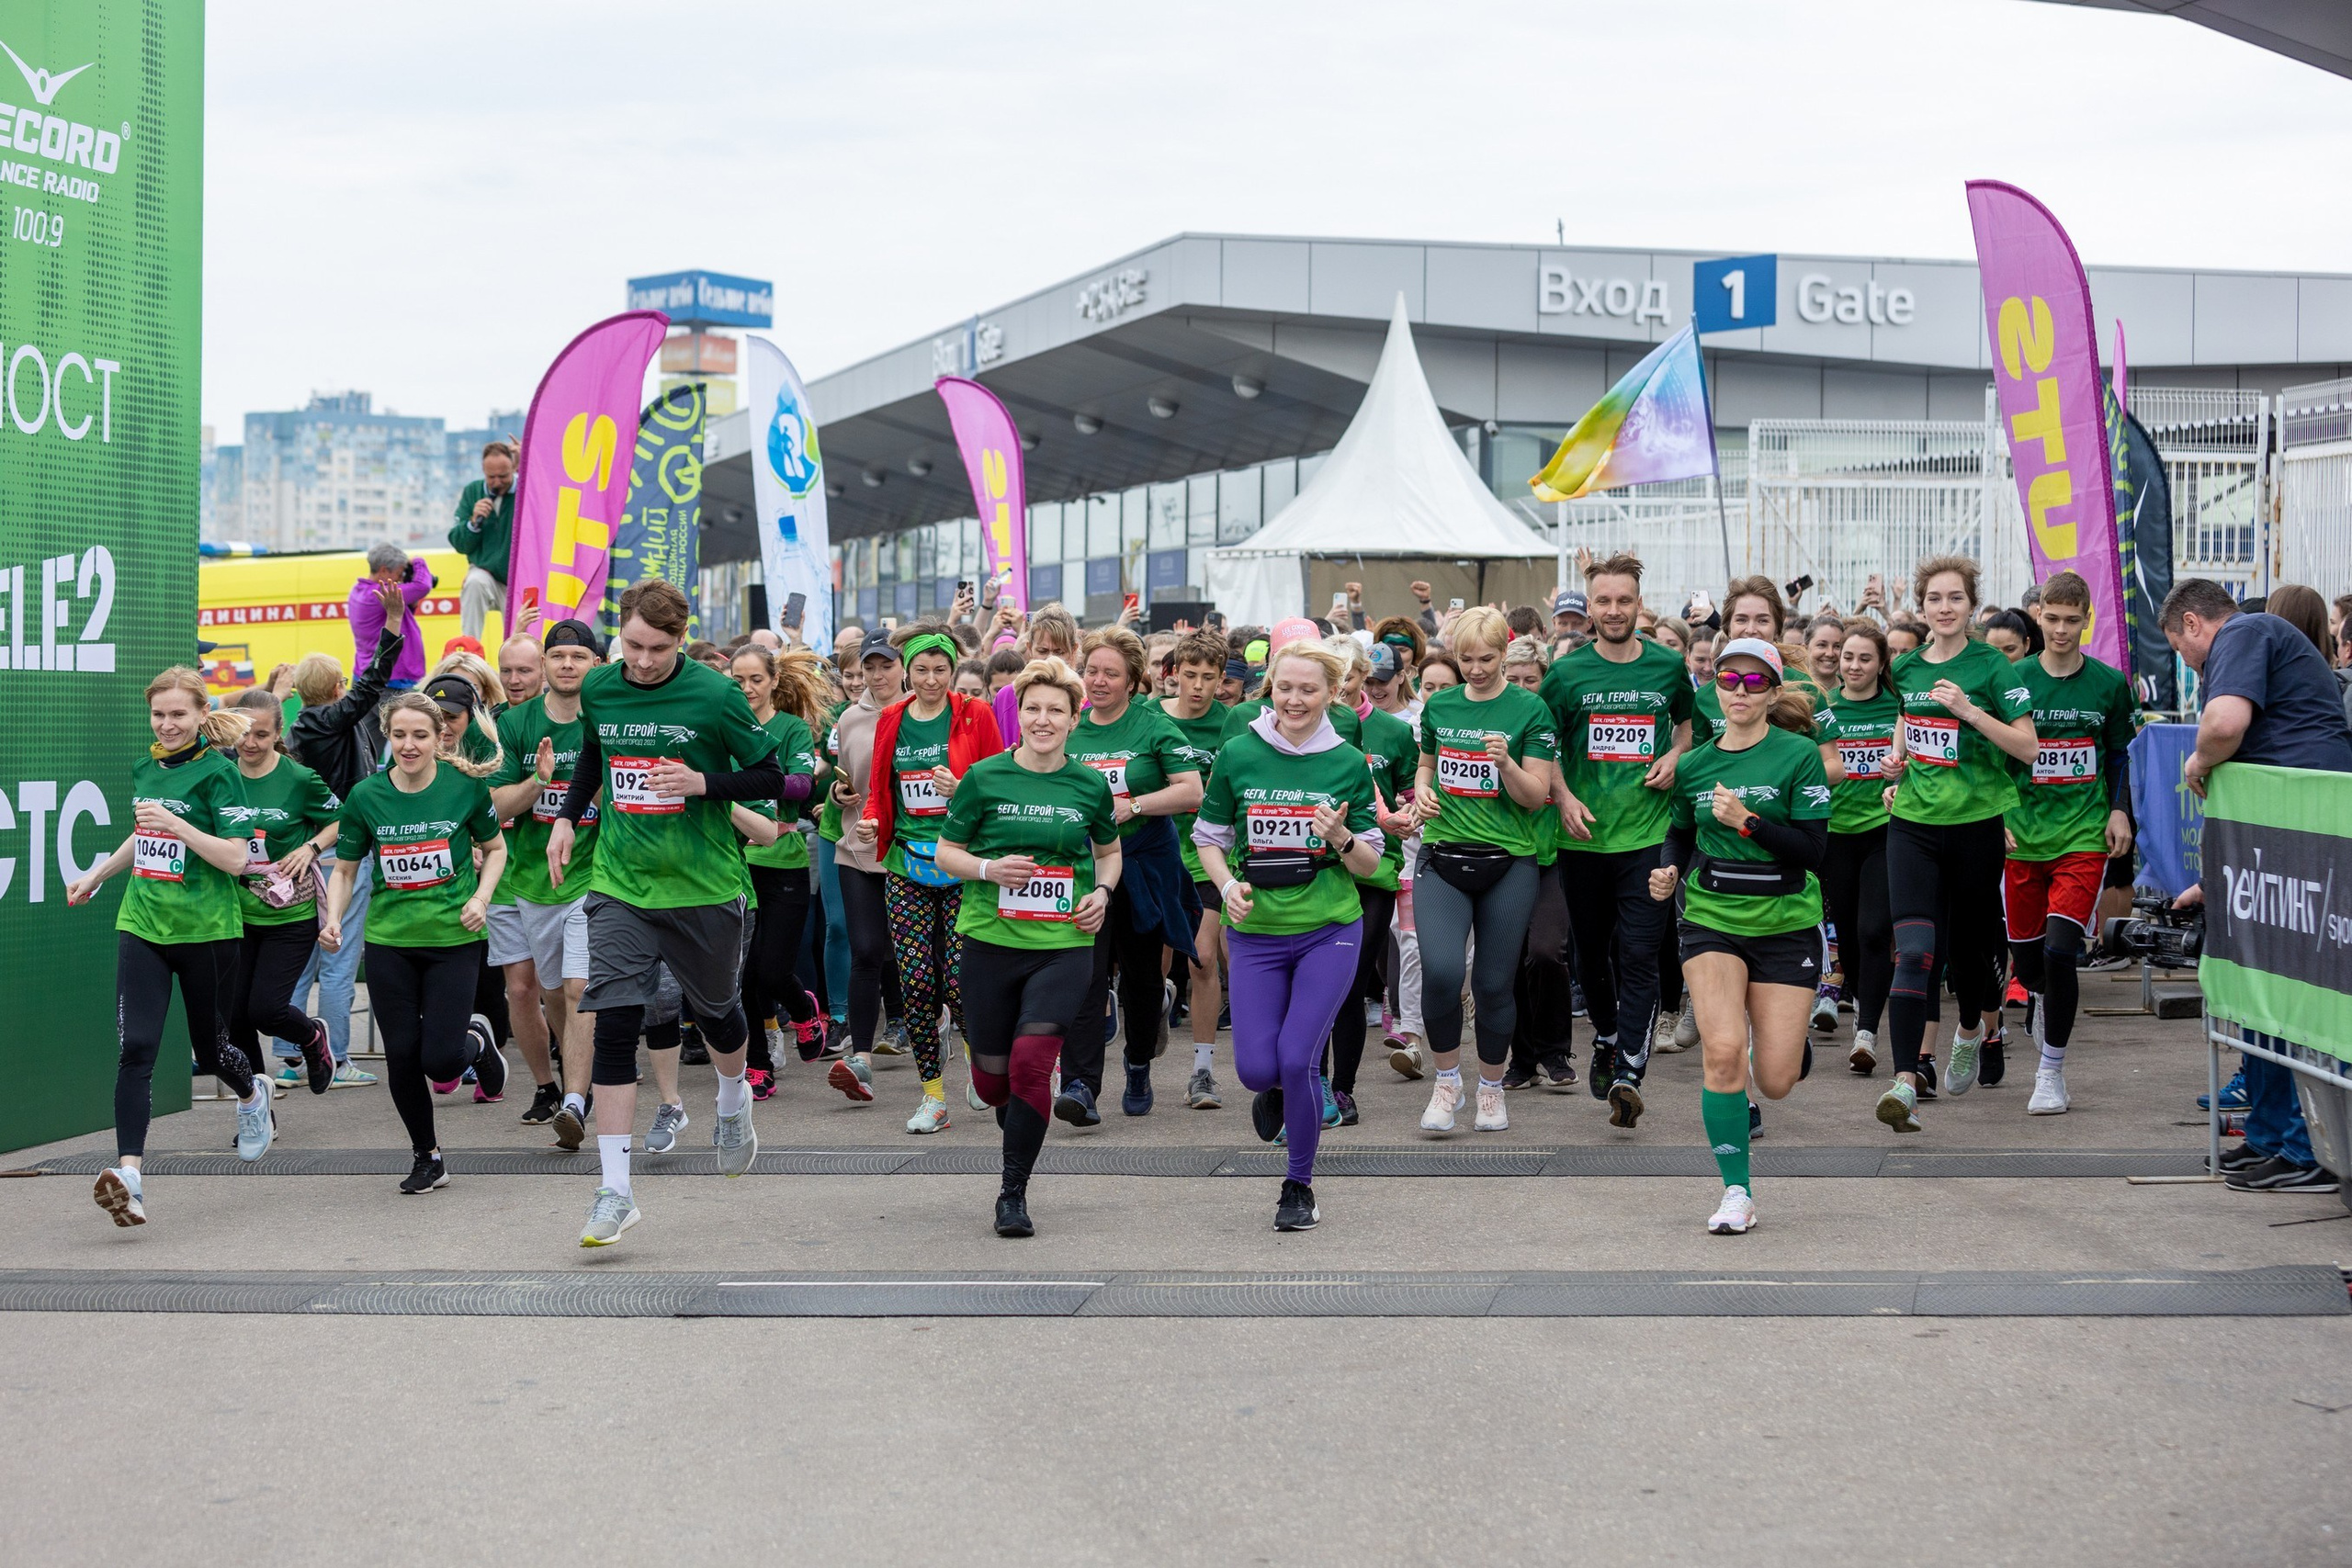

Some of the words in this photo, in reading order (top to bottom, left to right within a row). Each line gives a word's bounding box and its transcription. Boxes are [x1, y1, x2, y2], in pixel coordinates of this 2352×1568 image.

[42, 171, 100, 203] RADIO
[13, 206, 64, 248] 100.9
[1538, 265, 1671, 325] Вход
[1721, 270, 1746, 320] 1
[1797, 275, 1915, 326] Gate
[0, 341, 120, 444] ОСТ
[678, 510, 688, 554] РОССИИ
[1558, 598, 1584, 607] adidas
[1582, 693, 1604, 705] БЕГИ,
[1608, 690, 1639, 703] ГЕРОЙ!
[2032, 709, 2045, 721] ГИ,
[2049, 708, 2079, 721] ГЕРОЙ!
[598, 724, 619, 738] БЕГИ,
[623, 722, 658, 738] ГЕРОЙ!
[1456, 728, 1485, 739] ГЕРОЙ!
[1593, 727, 1647, 742] 09209
[1848, 723, 1875, 732] ГЕРОЙ!
[1906, 726, 1951, 748] 08119
[554, 750, 577, 763] ЕРОЙ!
[1080, 751, 1109, 761] ГЕРОЙ!
[2037, 750, 2088, 766] 08141
[1441, 760, 1491, 779] 09208
[615, 772, 650, 791] 092
[905, 783, 939, 798] 114
[1243, 789, 1267, 801] БЕГИ,
[1270, 789, 1305, 801] ГЕРОЙ!
[540, 792, 569, 807] 103
[998, 804, 1021, 816] БЕГИ,
[1023, 804, 1055, 817] ГЕРОЙ!
[377, 826, 398, 836] БЕГИ,
[400, 821, 428, 835] ГЕРОЙ!
[1252, 819, 1315, 836] 09211
[137, 839, 178, 860] 10640
[386, 853, 442, 873] 10641
